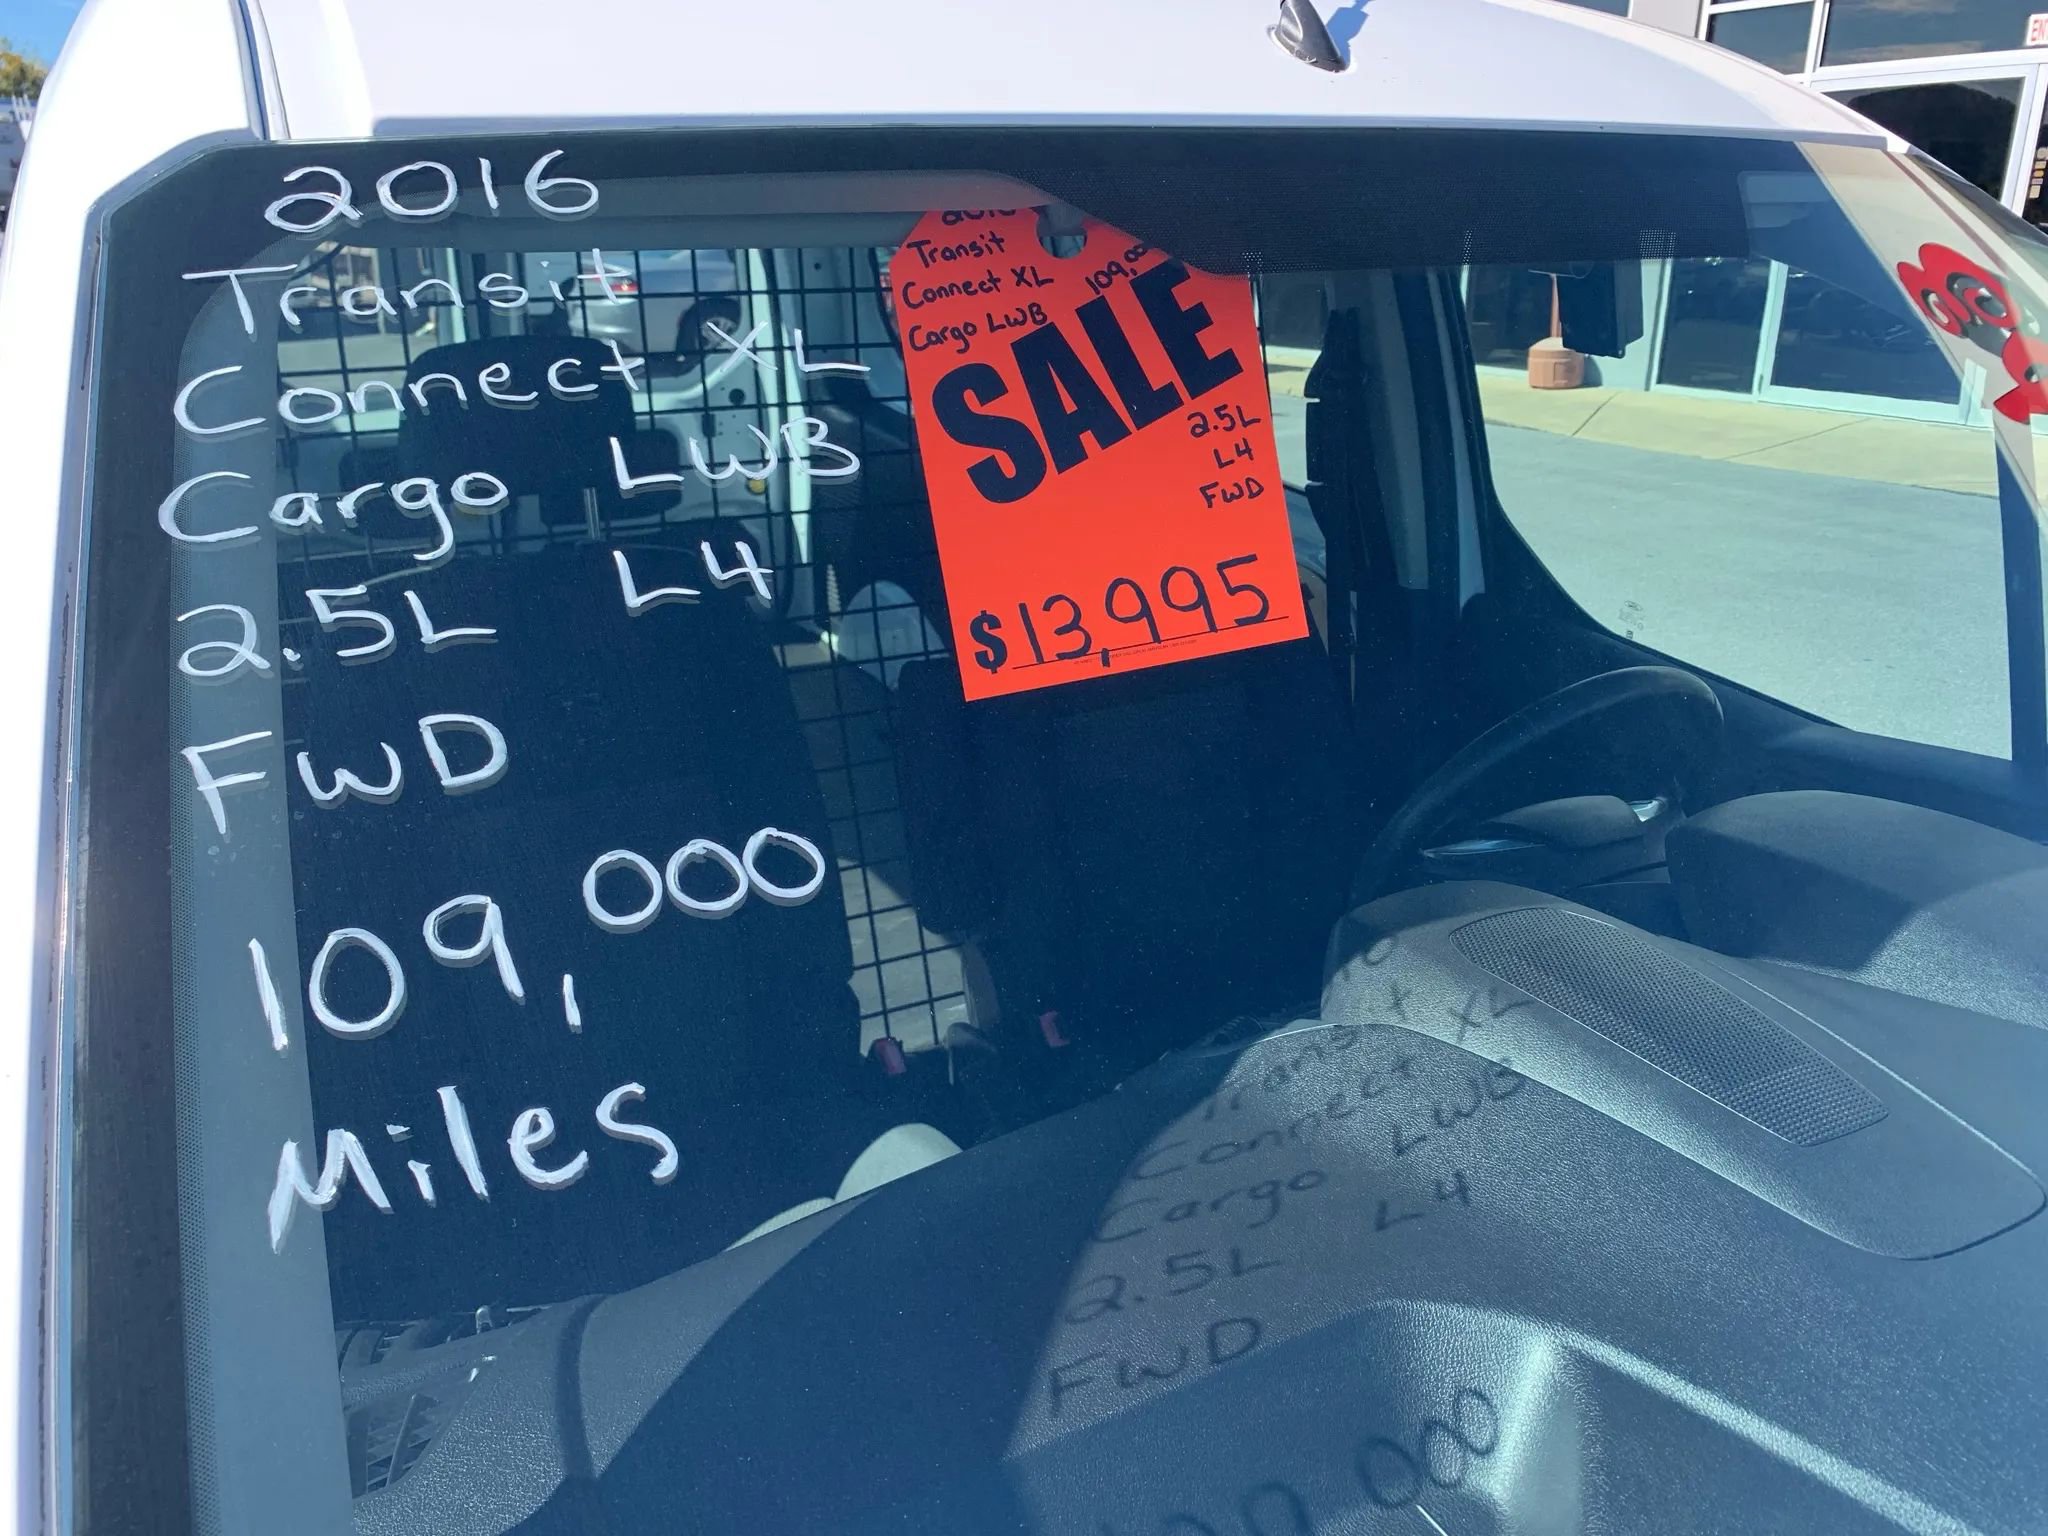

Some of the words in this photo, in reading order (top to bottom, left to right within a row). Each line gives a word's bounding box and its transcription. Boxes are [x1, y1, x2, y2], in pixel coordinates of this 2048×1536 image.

[263, 149, 600, 233] 2016
[181, 247, 638, 336] Transit
[901, 268, 1002, 310] Connect
[1010, 265, 1055, 289] XL
[906, 230, 1006, 269] Transit
[1085, 243, 1149, 295] 109,00
[908, 321, 978, 355] Cargo
[986, 301, 1049, 334] LWB
[173, 338, 646, 436] Connect
[702, 320, 871, 374] XL
[931, 261, 1245, 505] SALE
[1187, 404, 1262, 439] 2.5L
[1212, 438, 1255, 470] L4
[158, 471, 509, 561] Cargo
[610, 417, 861, 492] LWB
[1198, 475, 1265, 509] FWD
[176, 584, 498, 678] 2.5L
[612, 540, 775, 608] L4
[181, 712, 508, 835] FWD
[247, 826, 826, 1052] 109,000
[268, 1081, 679, 1255] Miles
